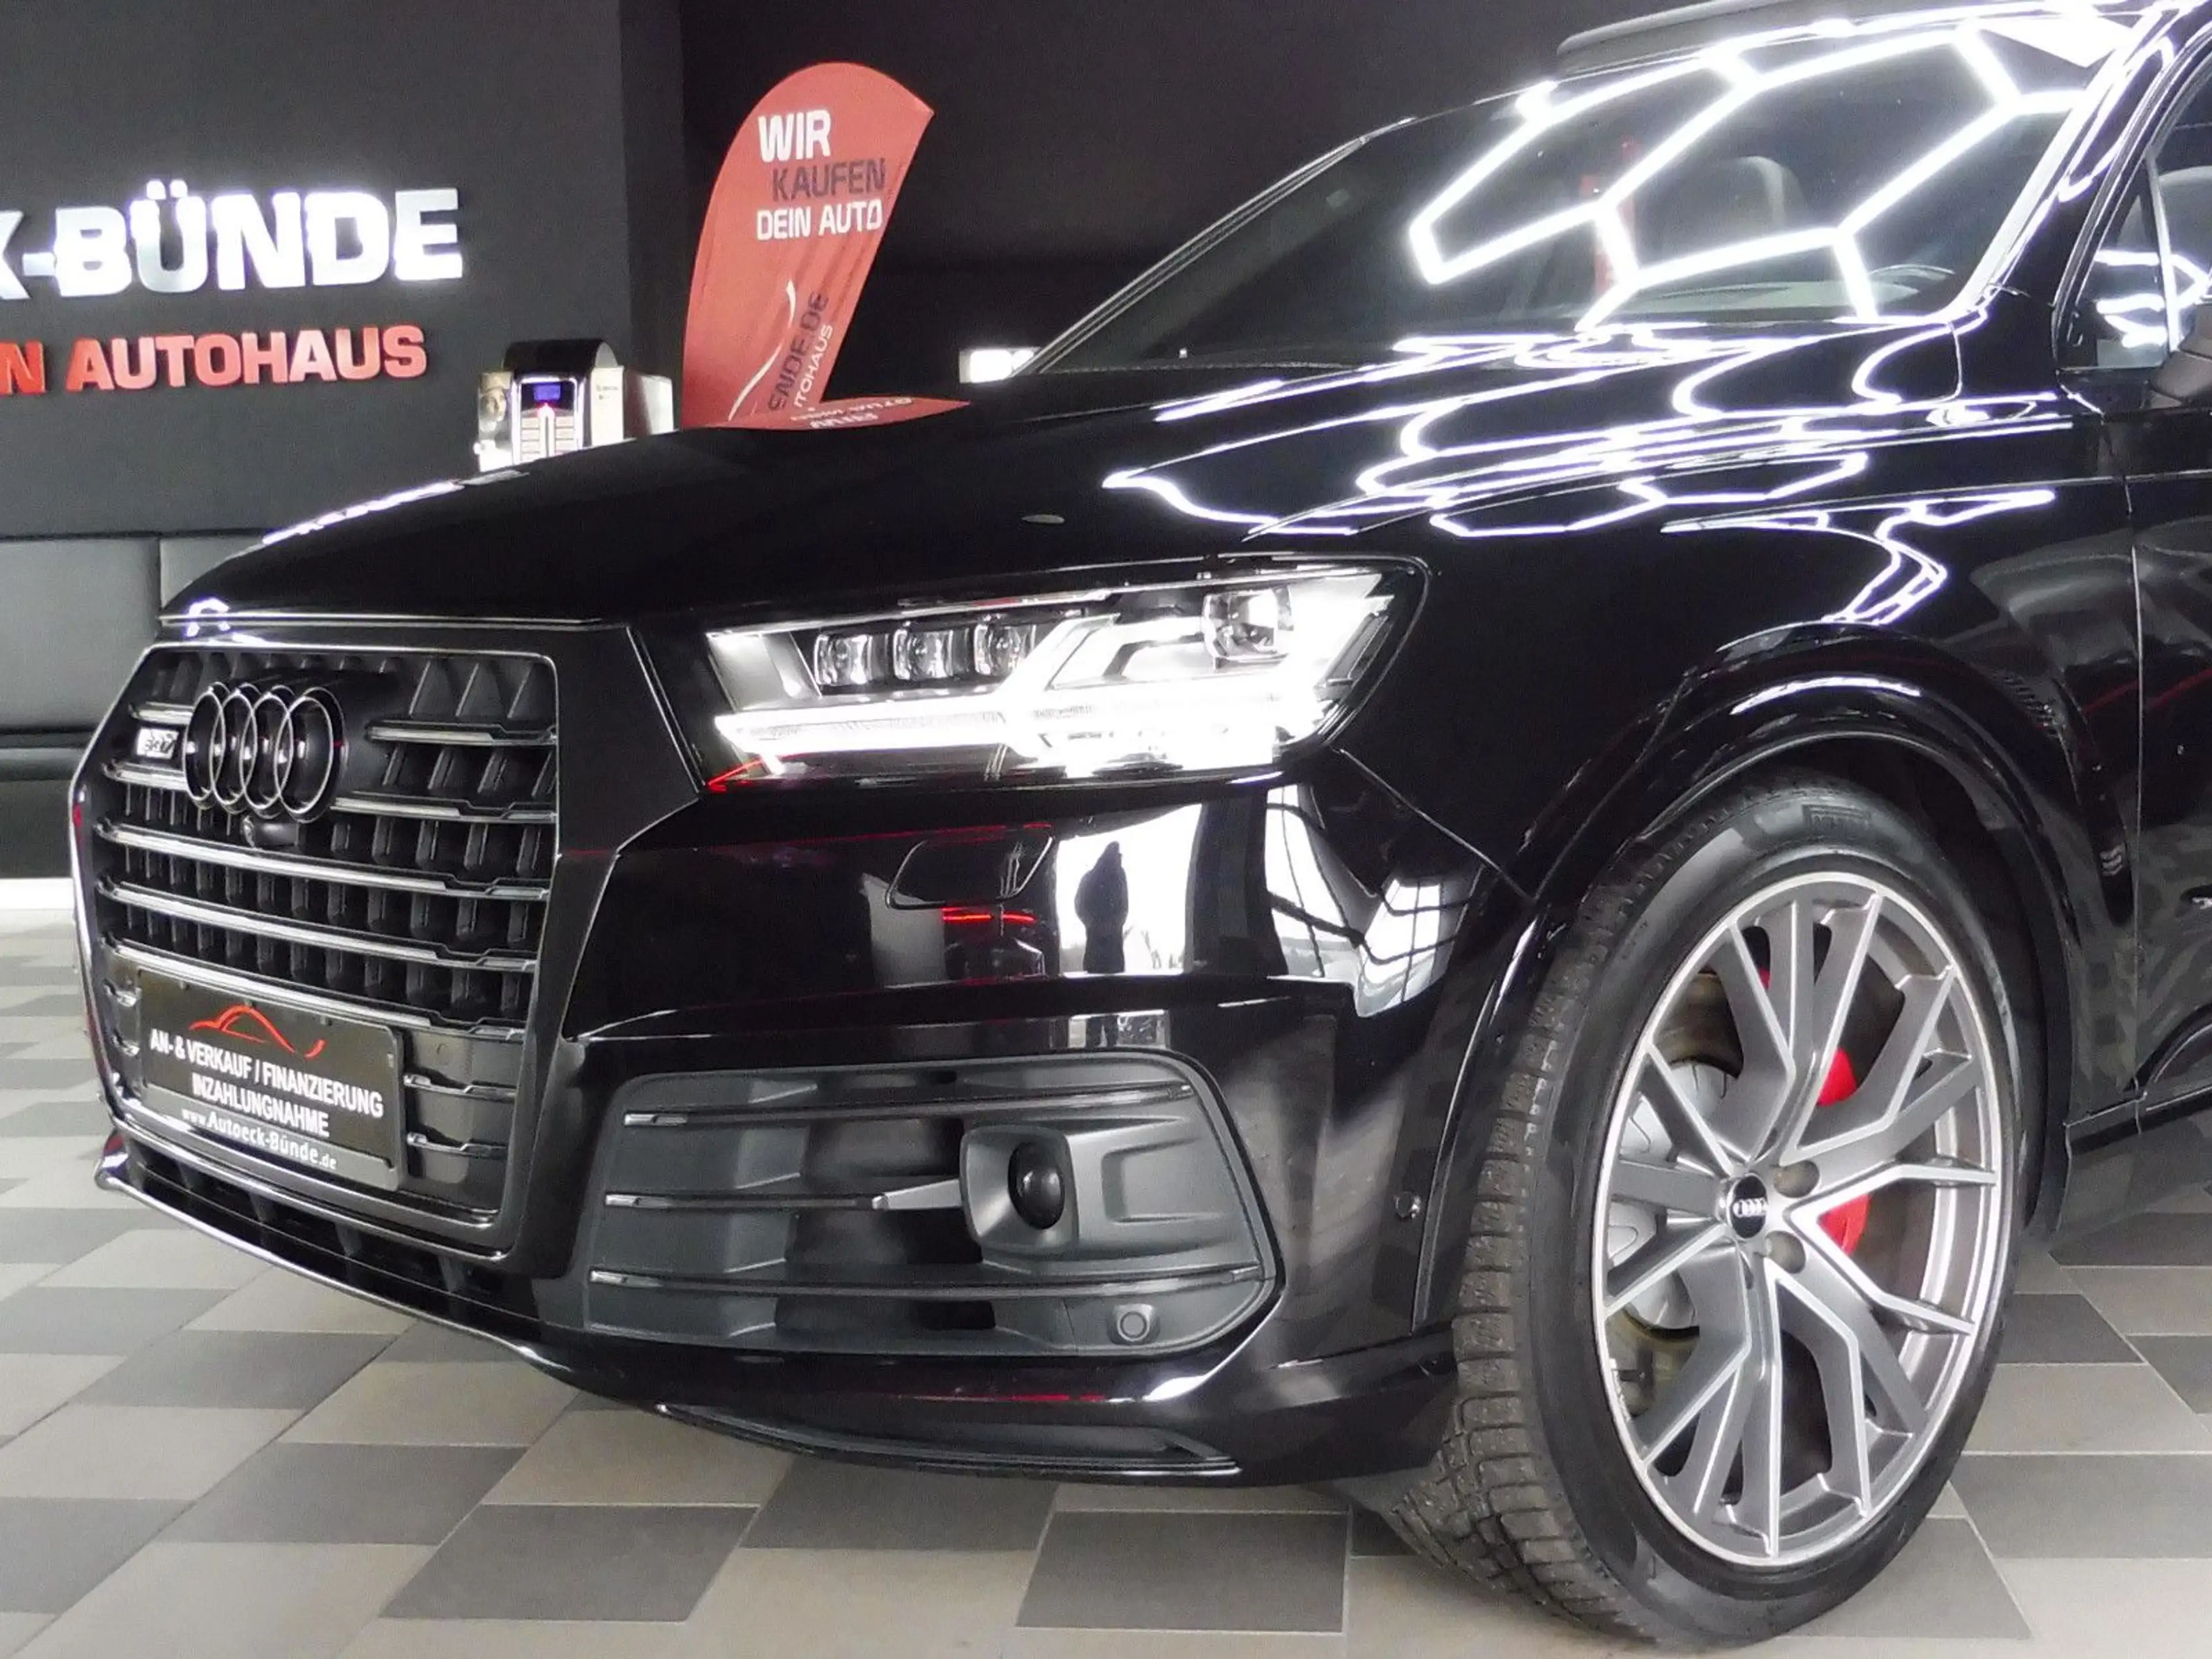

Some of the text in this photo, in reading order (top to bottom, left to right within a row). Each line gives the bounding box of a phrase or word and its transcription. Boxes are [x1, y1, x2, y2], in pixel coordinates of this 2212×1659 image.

[758, 109, 832, 162] WIR
[771, 157, 886, 202] KAUFEN
[757, 199, 882, 241] DEIN AUTO
[65, 324, 428, 393] AUTOHAUS
[175, 1035, 186, 1060] &
[186, 1039, 252, 1080] VERKAUF
[262, 1062, 384, 1119] FINANZIERUNG
[191, 1072, 330, 1138] INZAHLUNGNAHME
